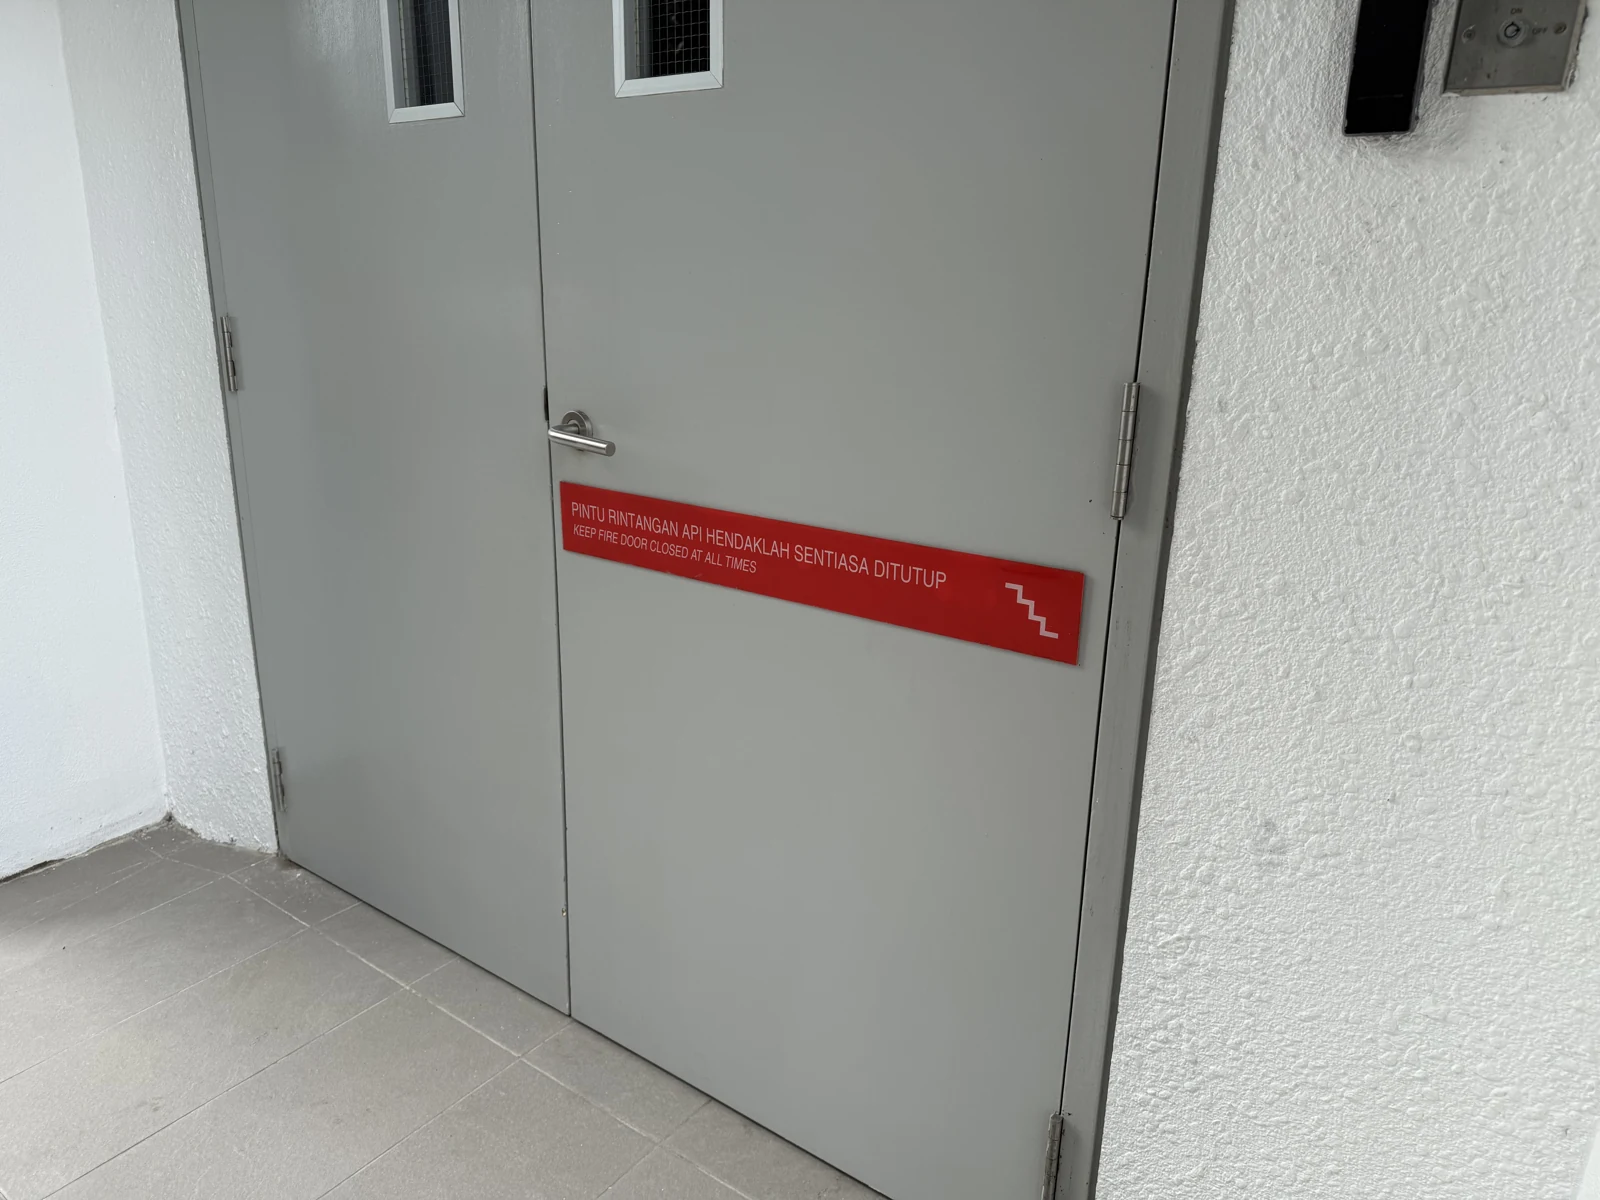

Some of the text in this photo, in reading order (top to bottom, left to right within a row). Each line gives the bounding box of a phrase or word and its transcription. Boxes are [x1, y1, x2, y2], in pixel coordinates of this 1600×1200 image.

[1532, 27, 1548, 35] OFF
[571, 501, 947, 589] PINTU RINTANGAN API HENDAKLAH SENTIASA DITUTUP
[573, 523, 757, 574] KEEP FIRE DOOR CLOSED AT ALL TIMES
